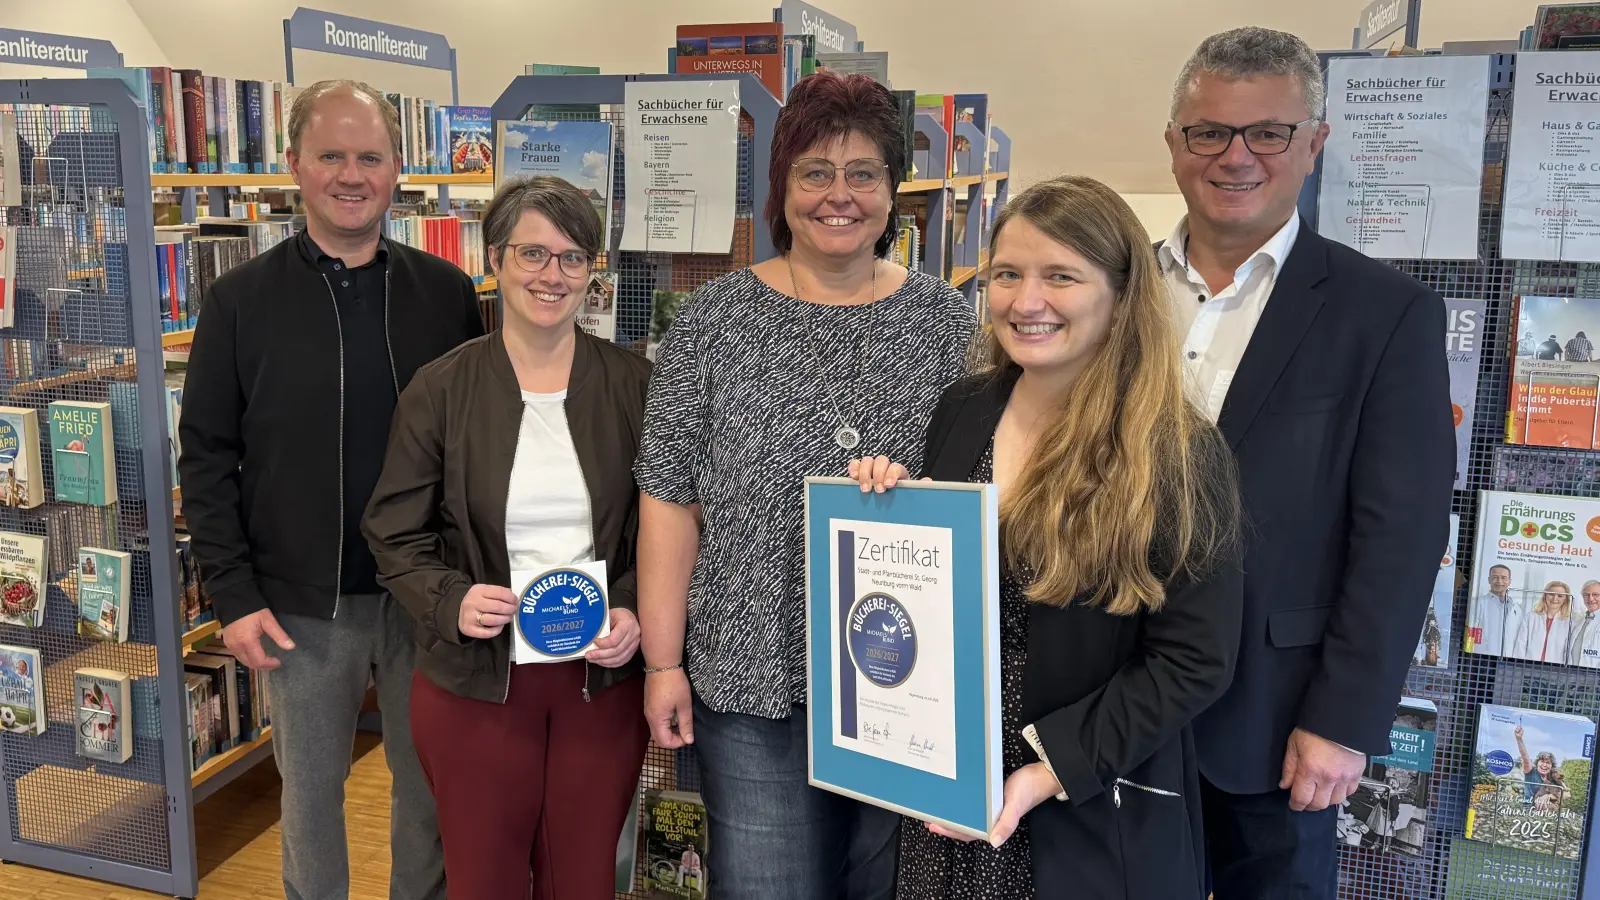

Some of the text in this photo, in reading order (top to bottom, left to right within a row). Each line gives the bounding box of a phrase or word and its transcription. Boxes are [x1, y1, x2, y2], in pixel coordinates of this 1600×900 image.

[801, 10, 845, 52] Sachliteratur
[324, 20, 428, 61] Romanliteratur
[693, 59, 763, 71] UNTERWEGS IN
[1346, 76, 1446, 90] Sachbücher für
[1346, 92, 1423, 103] Erwachsene
[637, 98, 724, 111] Sachbücher für
[641, 113, 708, 124] Erwachsene
[1344, 111, 1448, 122] Wirtschaft & Soziales
[1542, 121, 1571, 130] Haus
[1574, 121, 1584, 130] &
[643, 133, 670, 142] Reisen
[1352, 131, 1387, 140] Familie
[521, 141, 561, 152] Starke
[520, 152, 560, 163] Frauen
[1350, 154, 1417, 163] Lebensfragen
[643, 161, 670, 170] Bayern
[1538, 162, 1575, 172] Küche
[1577, 162, 1588, 172] &
[1347, 198, 1427, 207] Natur & Technik
[1535, 207, 1578, 217] Freizeit
[643, 214, 675, 224] Religion
[1346, 216, 1402, 224] Gesundheit
[1449, 309, 1477, 332] IS
[1446, 332, 1475, 352] TE
[1518, 383, 1546, 394] Wnn
[1549, 385, 1567, 395] der
[1517, 394, 1596, 407] in die Pubertät
[53, 408, 98, 424] AMELIE
[58, 421, 94, 435] FRIED
[1510, 499, 1524, 507] Die
[1501, 504, 1576, 523] Ernährungs
[1, 537, 19, 547] Unsere
[1498, 538, 1593, 557] Gesunde Haut
[0, 546, 24, 555] essbaren
[858, 536, 940, 569] Zertifikat
[0, 553, 36, 565] Wildpflanzen
[857, 566, 871, 575] Stadt-
[921, 575, 938, 585] Georg
[871, 578, 895, 590] Neunburg
[522, 573, 600, 614] BÜCHEREI-SIEGEL
[541, 604, 569, 614] MICHAELS
[563, 607, 579, 615] BUND
[853, 597, 912, 641] BÜCHEREI-SIEGEL
[541, 620, 585, 634] 2026/2027
[866, 647, 899, 663] 2026/2027
[1583, 648, 1598, 656] NDR
[80, 736, 119, 753] SOMMER
[1399, 742, 1419, 754] ZEIT
[1584, 736, 1593, 756] KOSMOS
[1486, 757, 1513, 768] KOSMOS
[652, 807, 701, 821] FAHR SCHON
[680, 803, 695, 813] ICH
[1496, 805, 1526, 817] Katrins
[656, 816, 694, 828] MAL DEN
[655, 823, 699, 837] ROLLSTUHL
[1510, 819, 1556, 839] 2025
